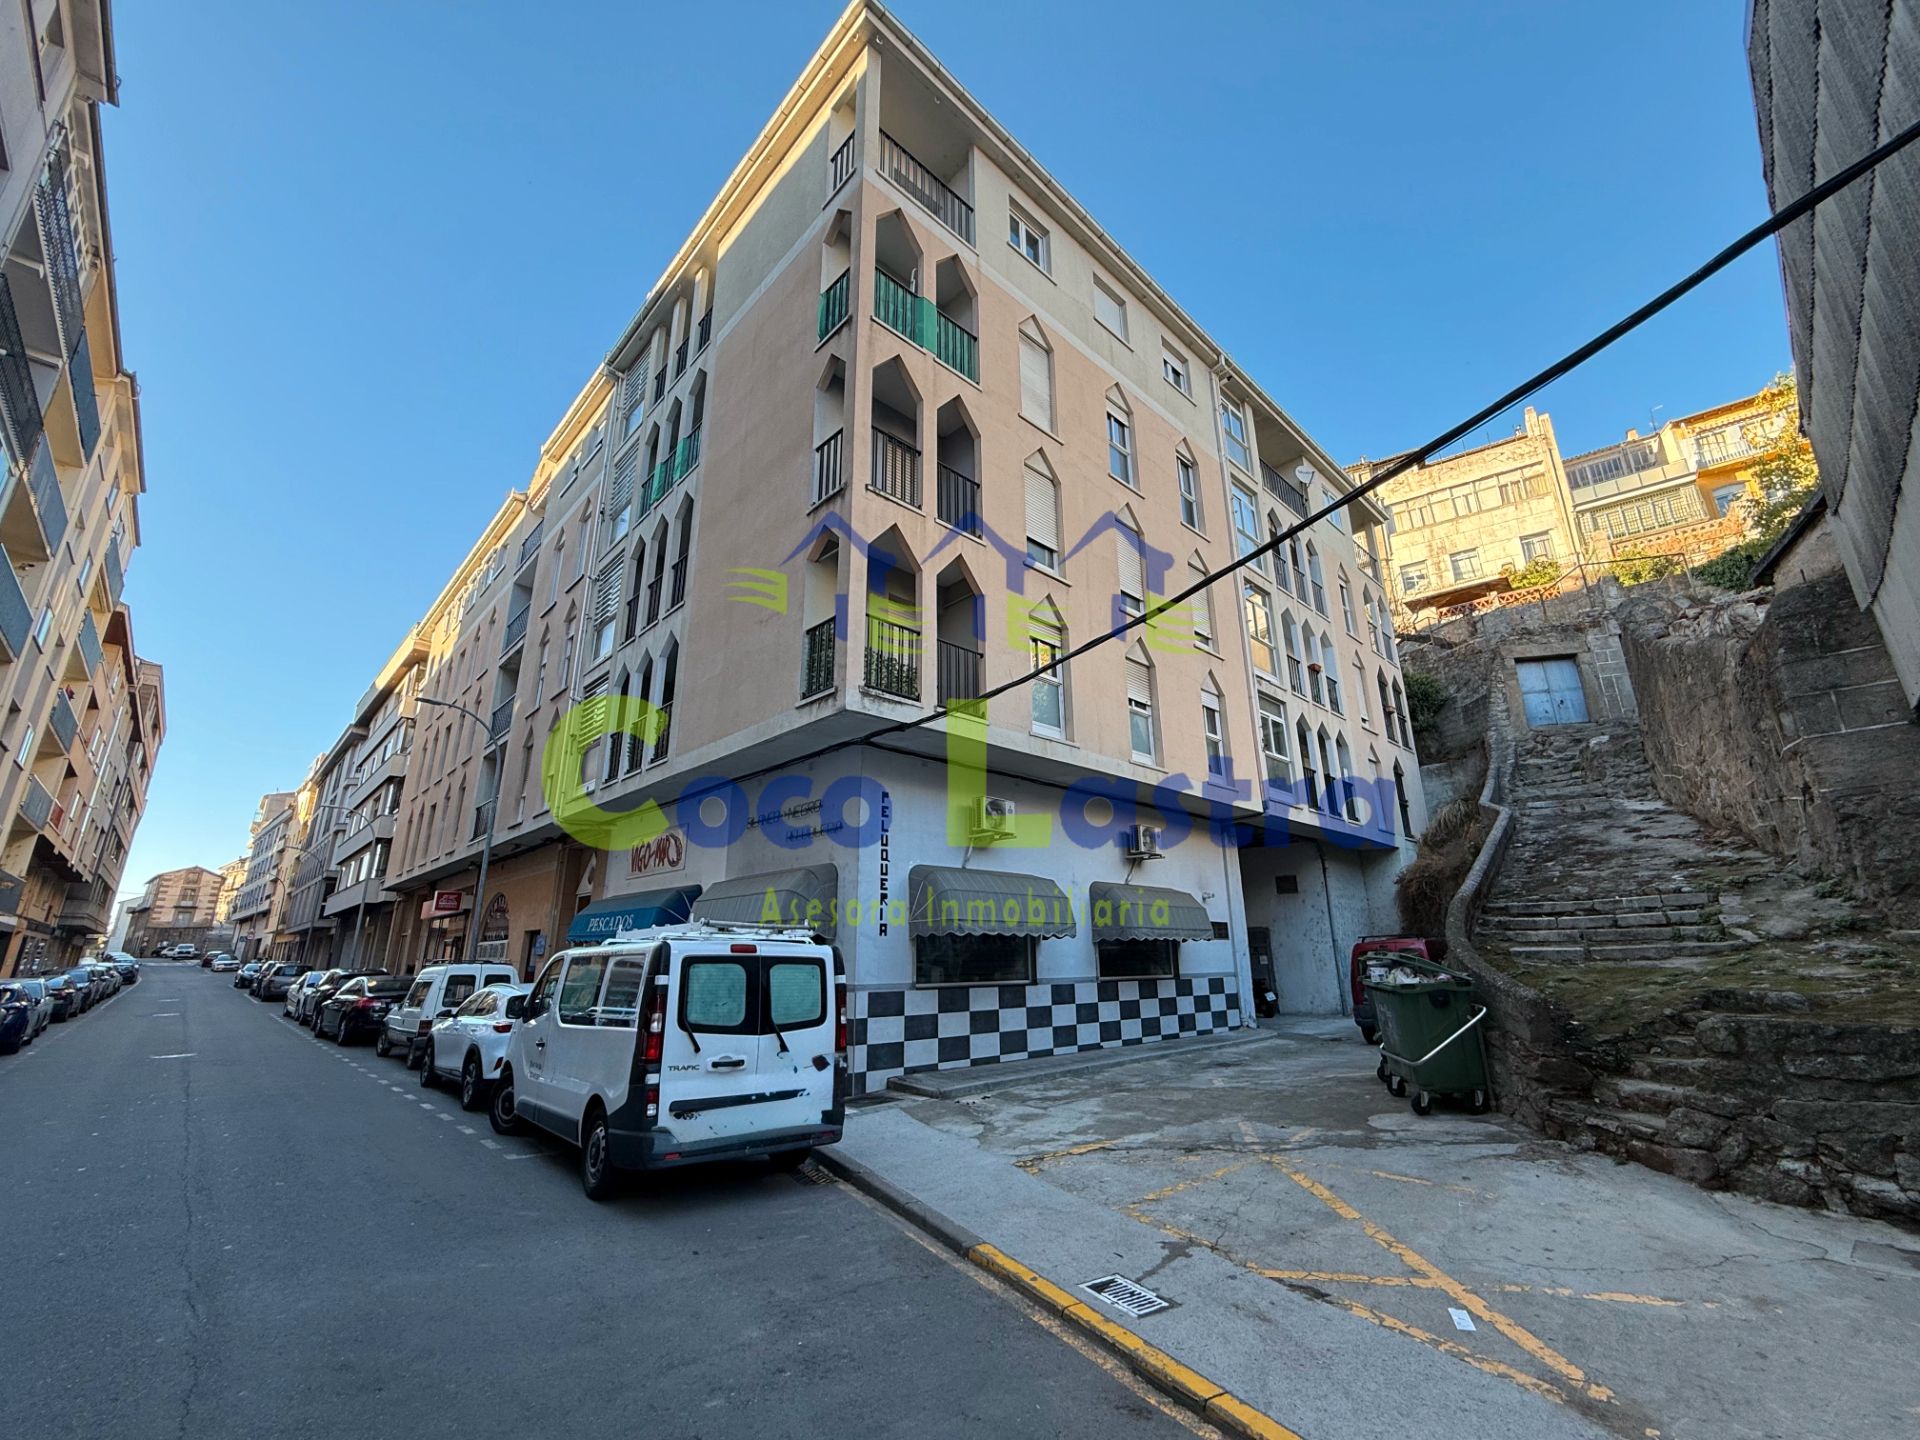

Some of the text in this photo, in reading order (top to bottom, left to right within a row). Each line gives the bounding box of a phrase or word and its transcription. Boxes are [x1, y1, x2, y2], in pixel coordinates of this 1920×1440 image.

[879, 791, 890, 937] PELUQUERIA
[587, 914, 635, 932] PESCADOS
[667, 1064, 701, 1072] TRAFIC
